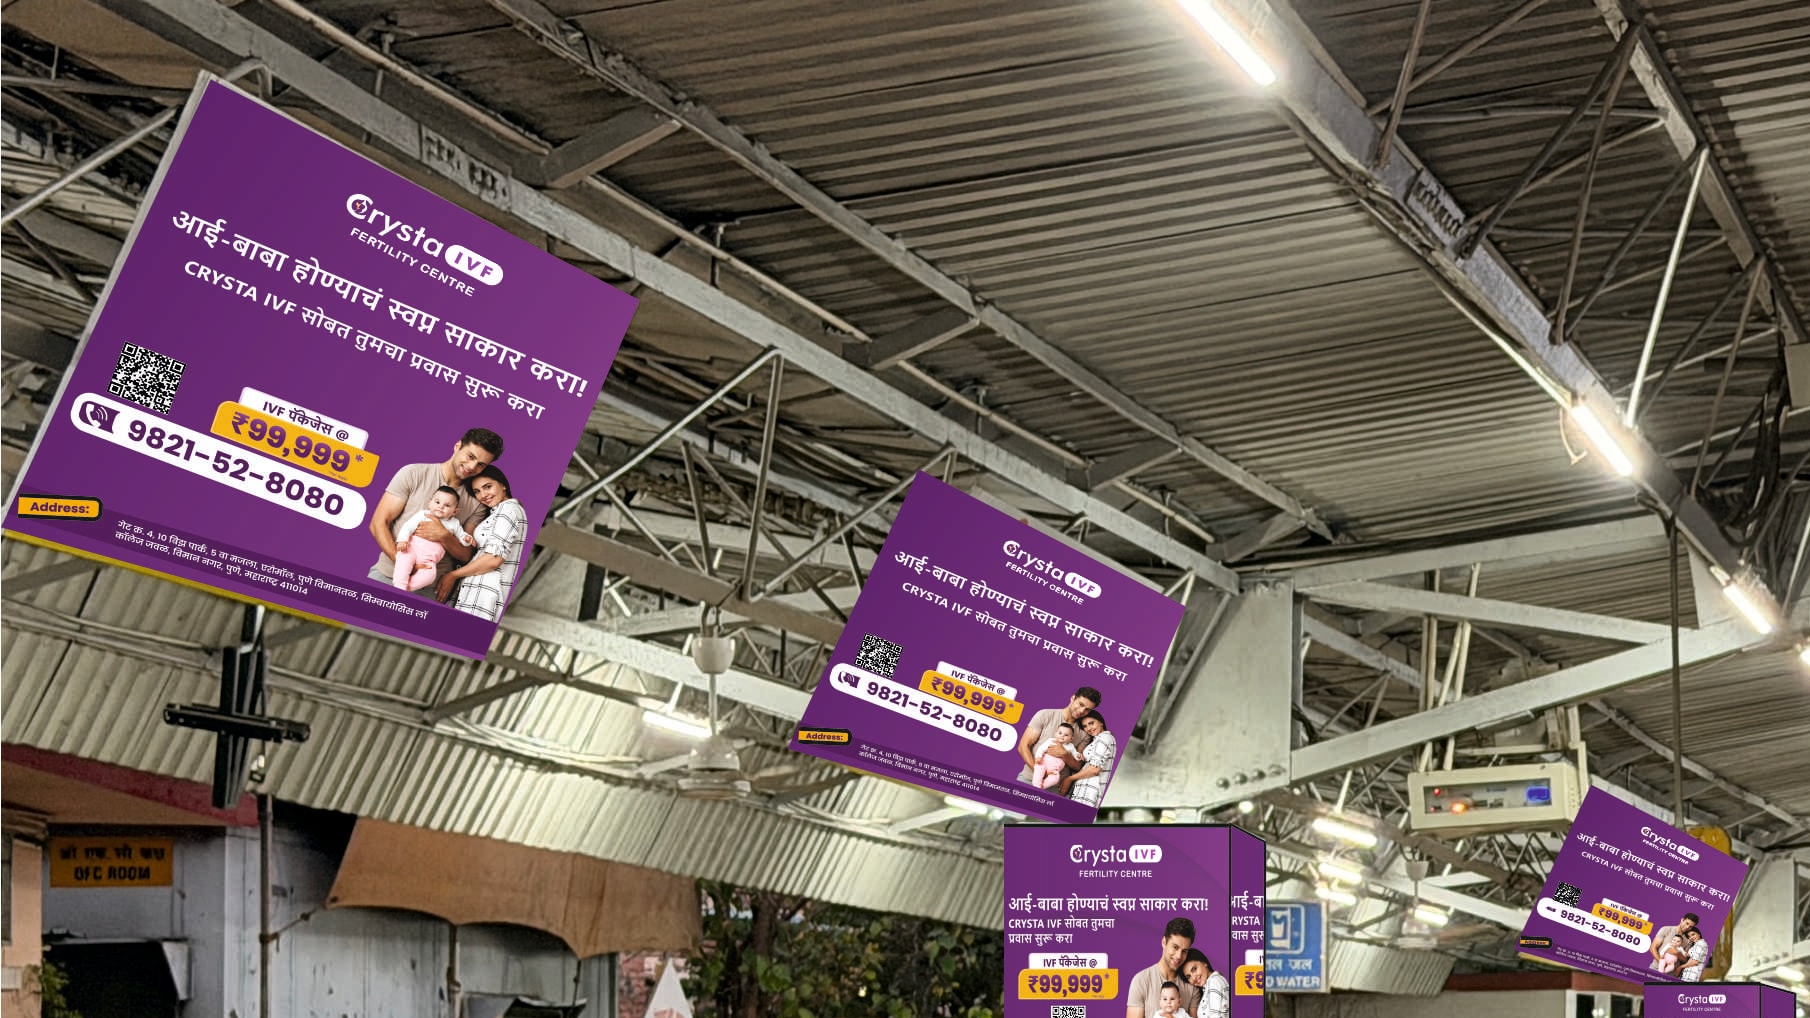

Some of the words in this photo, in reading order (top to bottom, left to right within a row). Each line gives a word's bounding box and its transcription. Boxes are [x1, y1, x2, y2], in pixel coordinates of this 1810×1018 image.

[346, 193, 443, 257] Crysta
[454, 252, 492, 277] IVF
[350, 227, 418, 266] FERTILITY
[420, 263, 474, 296] CENTRE
[173, 211, 288, 271] आई-बाबा
[293, 257, 383, 310] होण्याचं
[388, 298, 440, 334] स्वप्न
[445, 322, 525, 370] साकार
[530, 358, 587, 397] करा!
[184, 261, 256, 301] CRYSTA
[263, 293, 297, 314] IVF
[302, 306, 352, 339] सोबत
[355, 330, 407, 361] तुमचा
[410, 352, 461, 384] प्रवास
[465, 375, 504, 398] सुरू
[507, 392, 545, 419] करा
[128, 419, 344, 515] 9821-52-8080
[30, 501, 90, 514] Address:
[157, 532, 167, 541] 10
[211, 549, 217, 557] 5
[1003, 540, 1064, 580] Crysta
[1071, 577, 1095, 592] IVF
[279, 580, 308, 596] 411014
[1005, 561, 1048, 586] FERTILITY
[1049, 584, 1084, 604] CENTRE
[895, 551, 967, 589] आई-बाबा
[969, 580, 1026, 613] होण्याचं
[1029, 605, 1062, 628] स्वप्न
[1064, 620, 1115, 650] साकार
[1118, 643, 1154, 668] करा!
[902, 582, 947, 608] CRYSTA
[951, 602, 972, 616] IVF
[975, 611, 1007, 631] सोबत
[1008, 625, 1041, 645] तुमचा
[1042, 639, 1075, 659] प्रवास
[1077, 653, 1102, 668] सुरू
[1103, 664, 1128, 681] करा
[866, 681, 1002, 742] 9821-52-8080
[1070, 845, 1127, 867] Crysta
[1134, 849, 1157, 860] IVF
[108, 866, 151, 880] ROOM
[1079, 870, 1119, 878] FERTILITY
[1120, 870, 1153, 878] CENTRE
[1008, 893, 1064, 914] आई-बाबा
[1066, 893, 1110, 913] होण्याचं
[1139, 897, 1178, 911] साकार
[1181, 898, 1209, 911] करा!
[1008, 918, 1044, 929] CRYSTA
[1047, 919, 1062, 928] IVF
[1231, 916, 1260, 926] RYSTA
[1560, 910, 1641, 948] 9821-52-8080
[1055, 933, 1073, 944] करा
[1043, 958, 1057, 968] IVF
[1089, 959, 1098, 968] @
[1276, 976, 1321, 989] WATER
